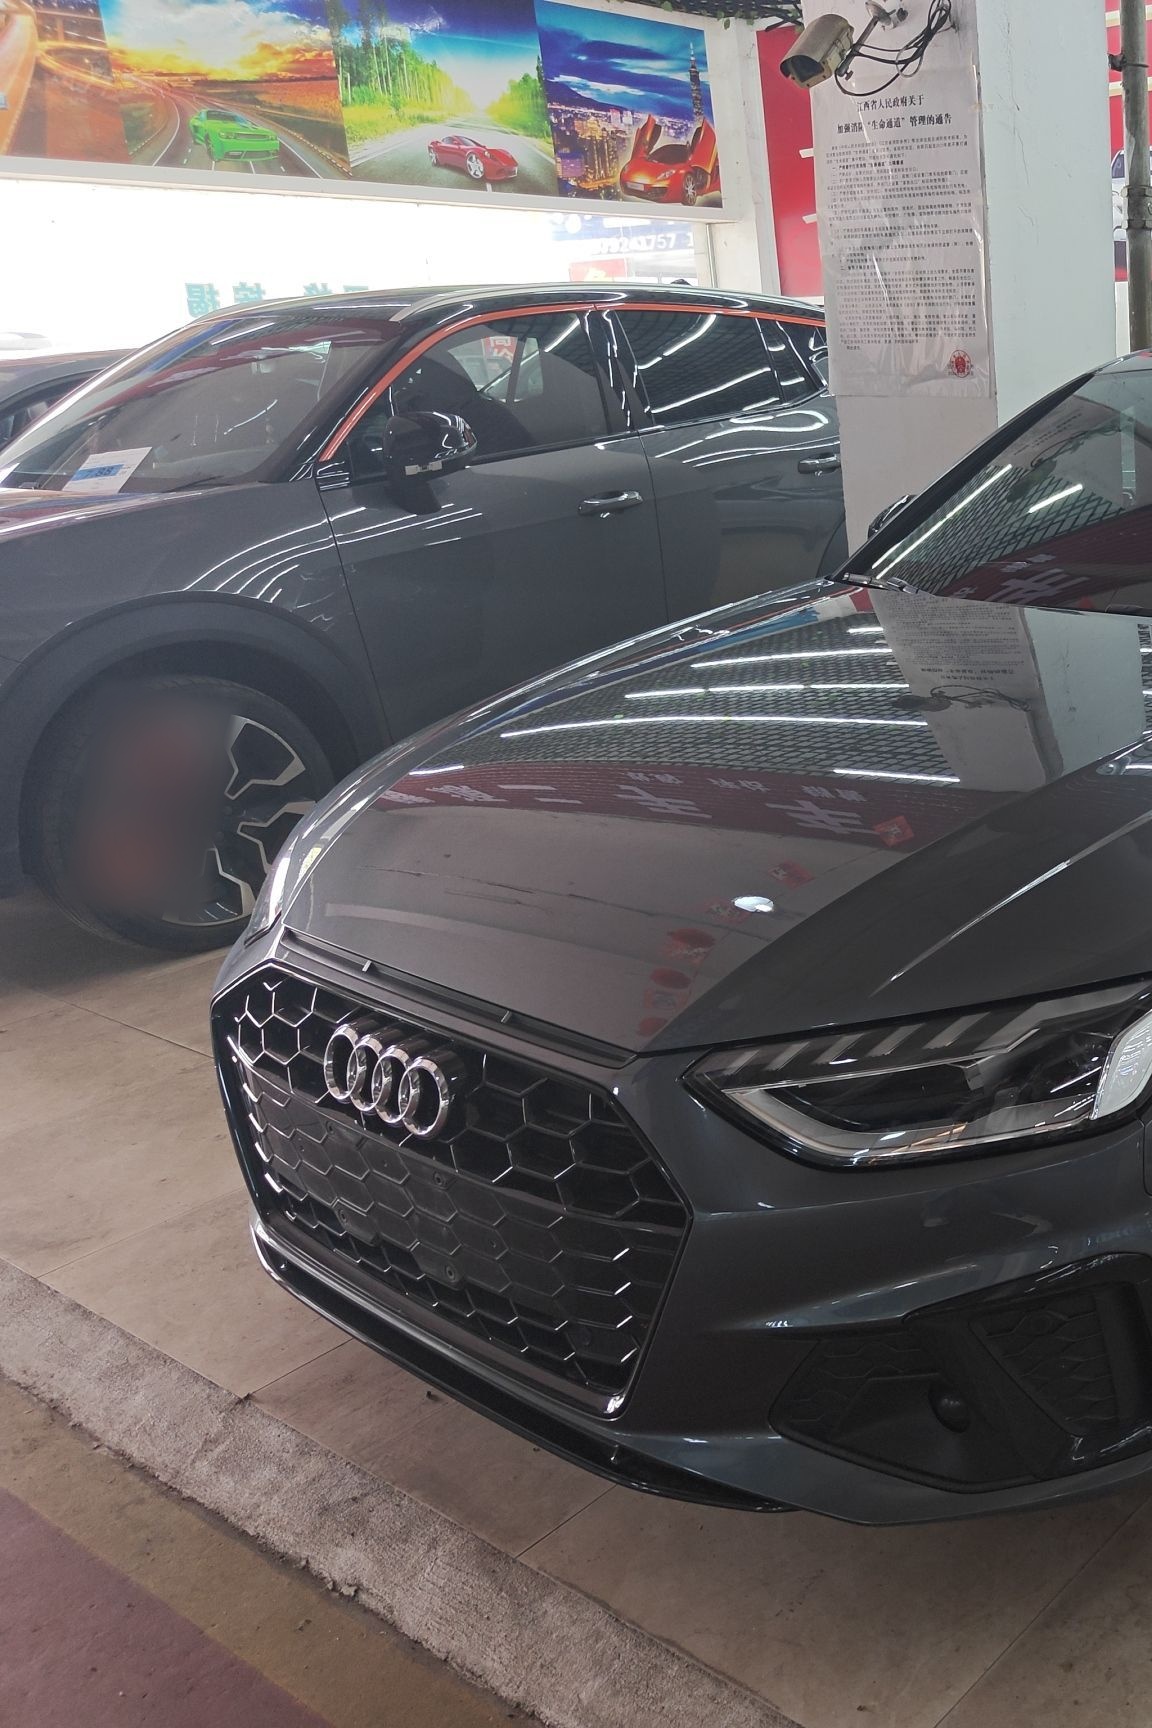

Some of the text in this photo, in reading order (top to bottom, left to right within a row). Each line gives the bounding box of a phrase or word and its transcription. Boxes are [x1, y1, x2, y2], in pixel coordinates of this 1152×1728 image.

[856, 94, 924, 112] 江西省人民政府关于
